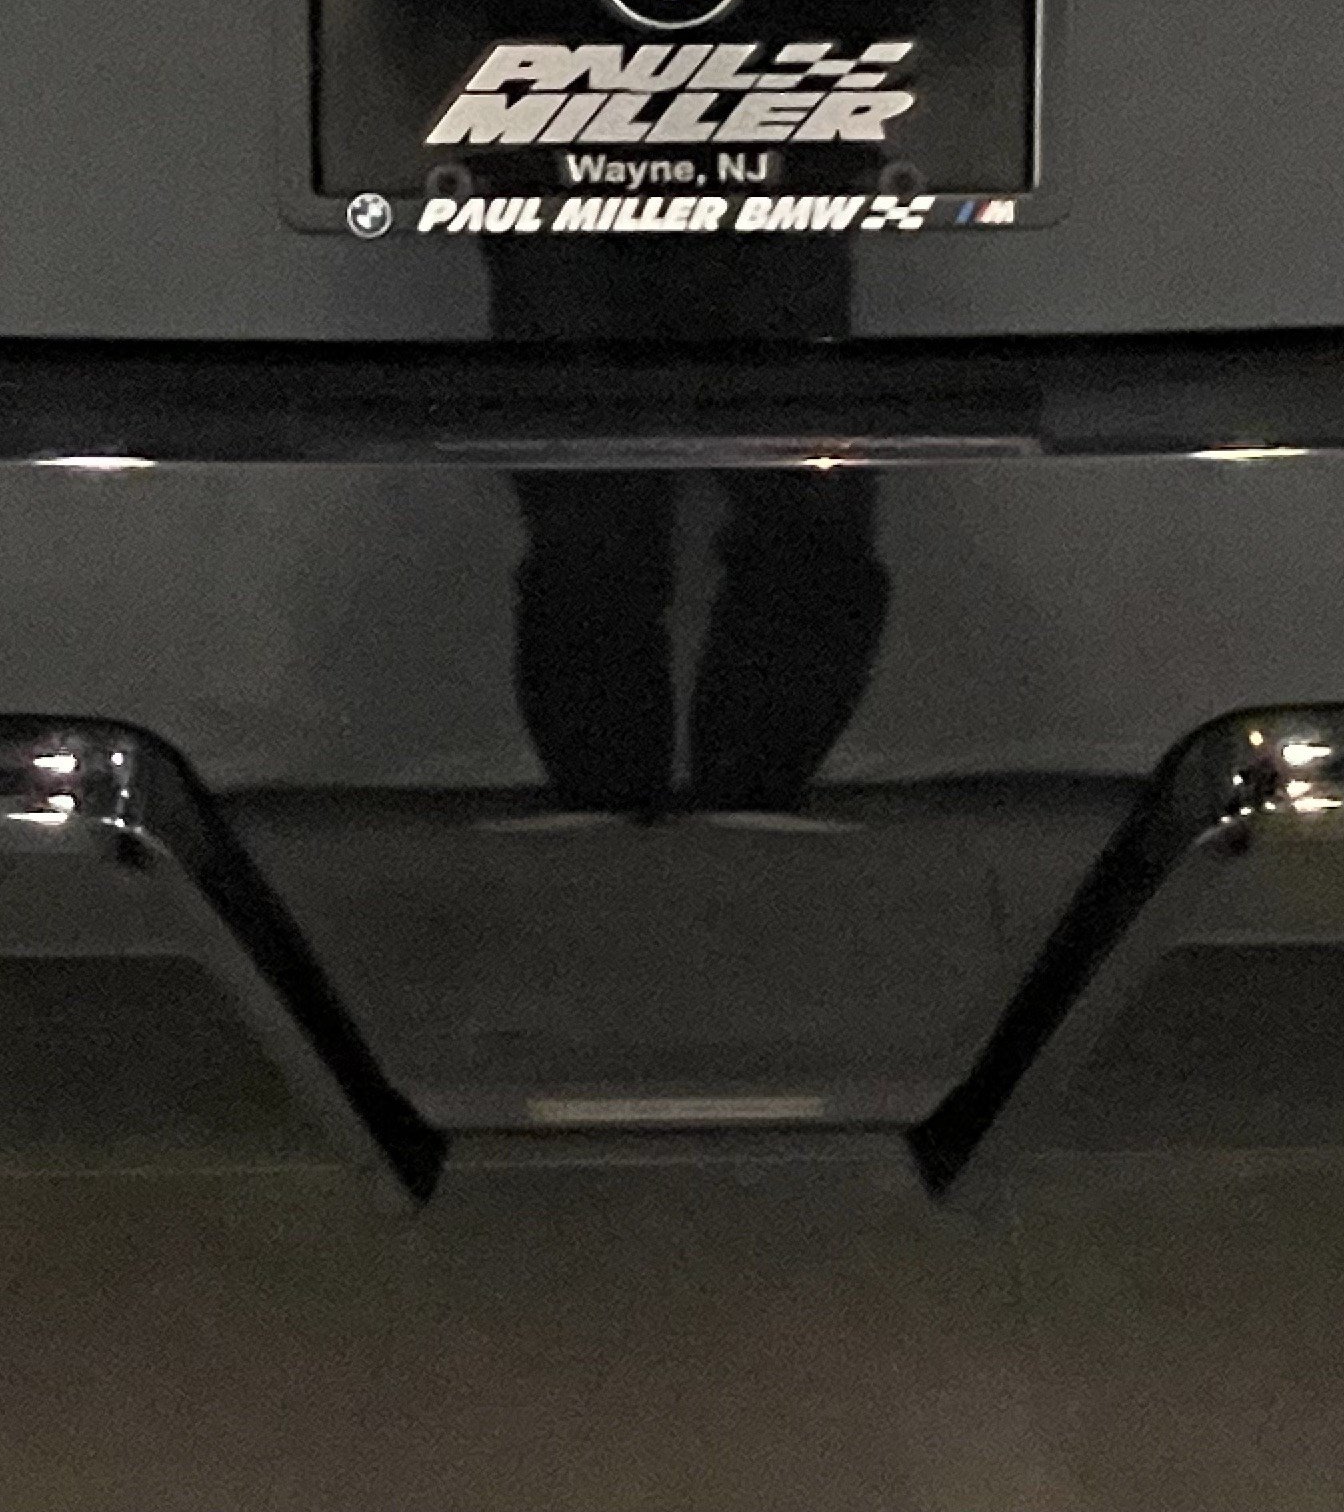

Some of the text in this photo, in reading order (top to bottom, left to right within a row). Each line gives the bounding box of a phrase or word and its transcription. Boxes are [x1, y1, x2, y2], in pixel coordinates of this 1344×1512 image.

[464, 43, 759, 92] PAUL
[425, 90, 916, 144] MILLER
[566, 152, 768, 187] Wayne, NJ
[417, 196, 543, 232] PAUL
[552, 196, 727, 232] MILLER
[733, 196, 866, 232] BMW
